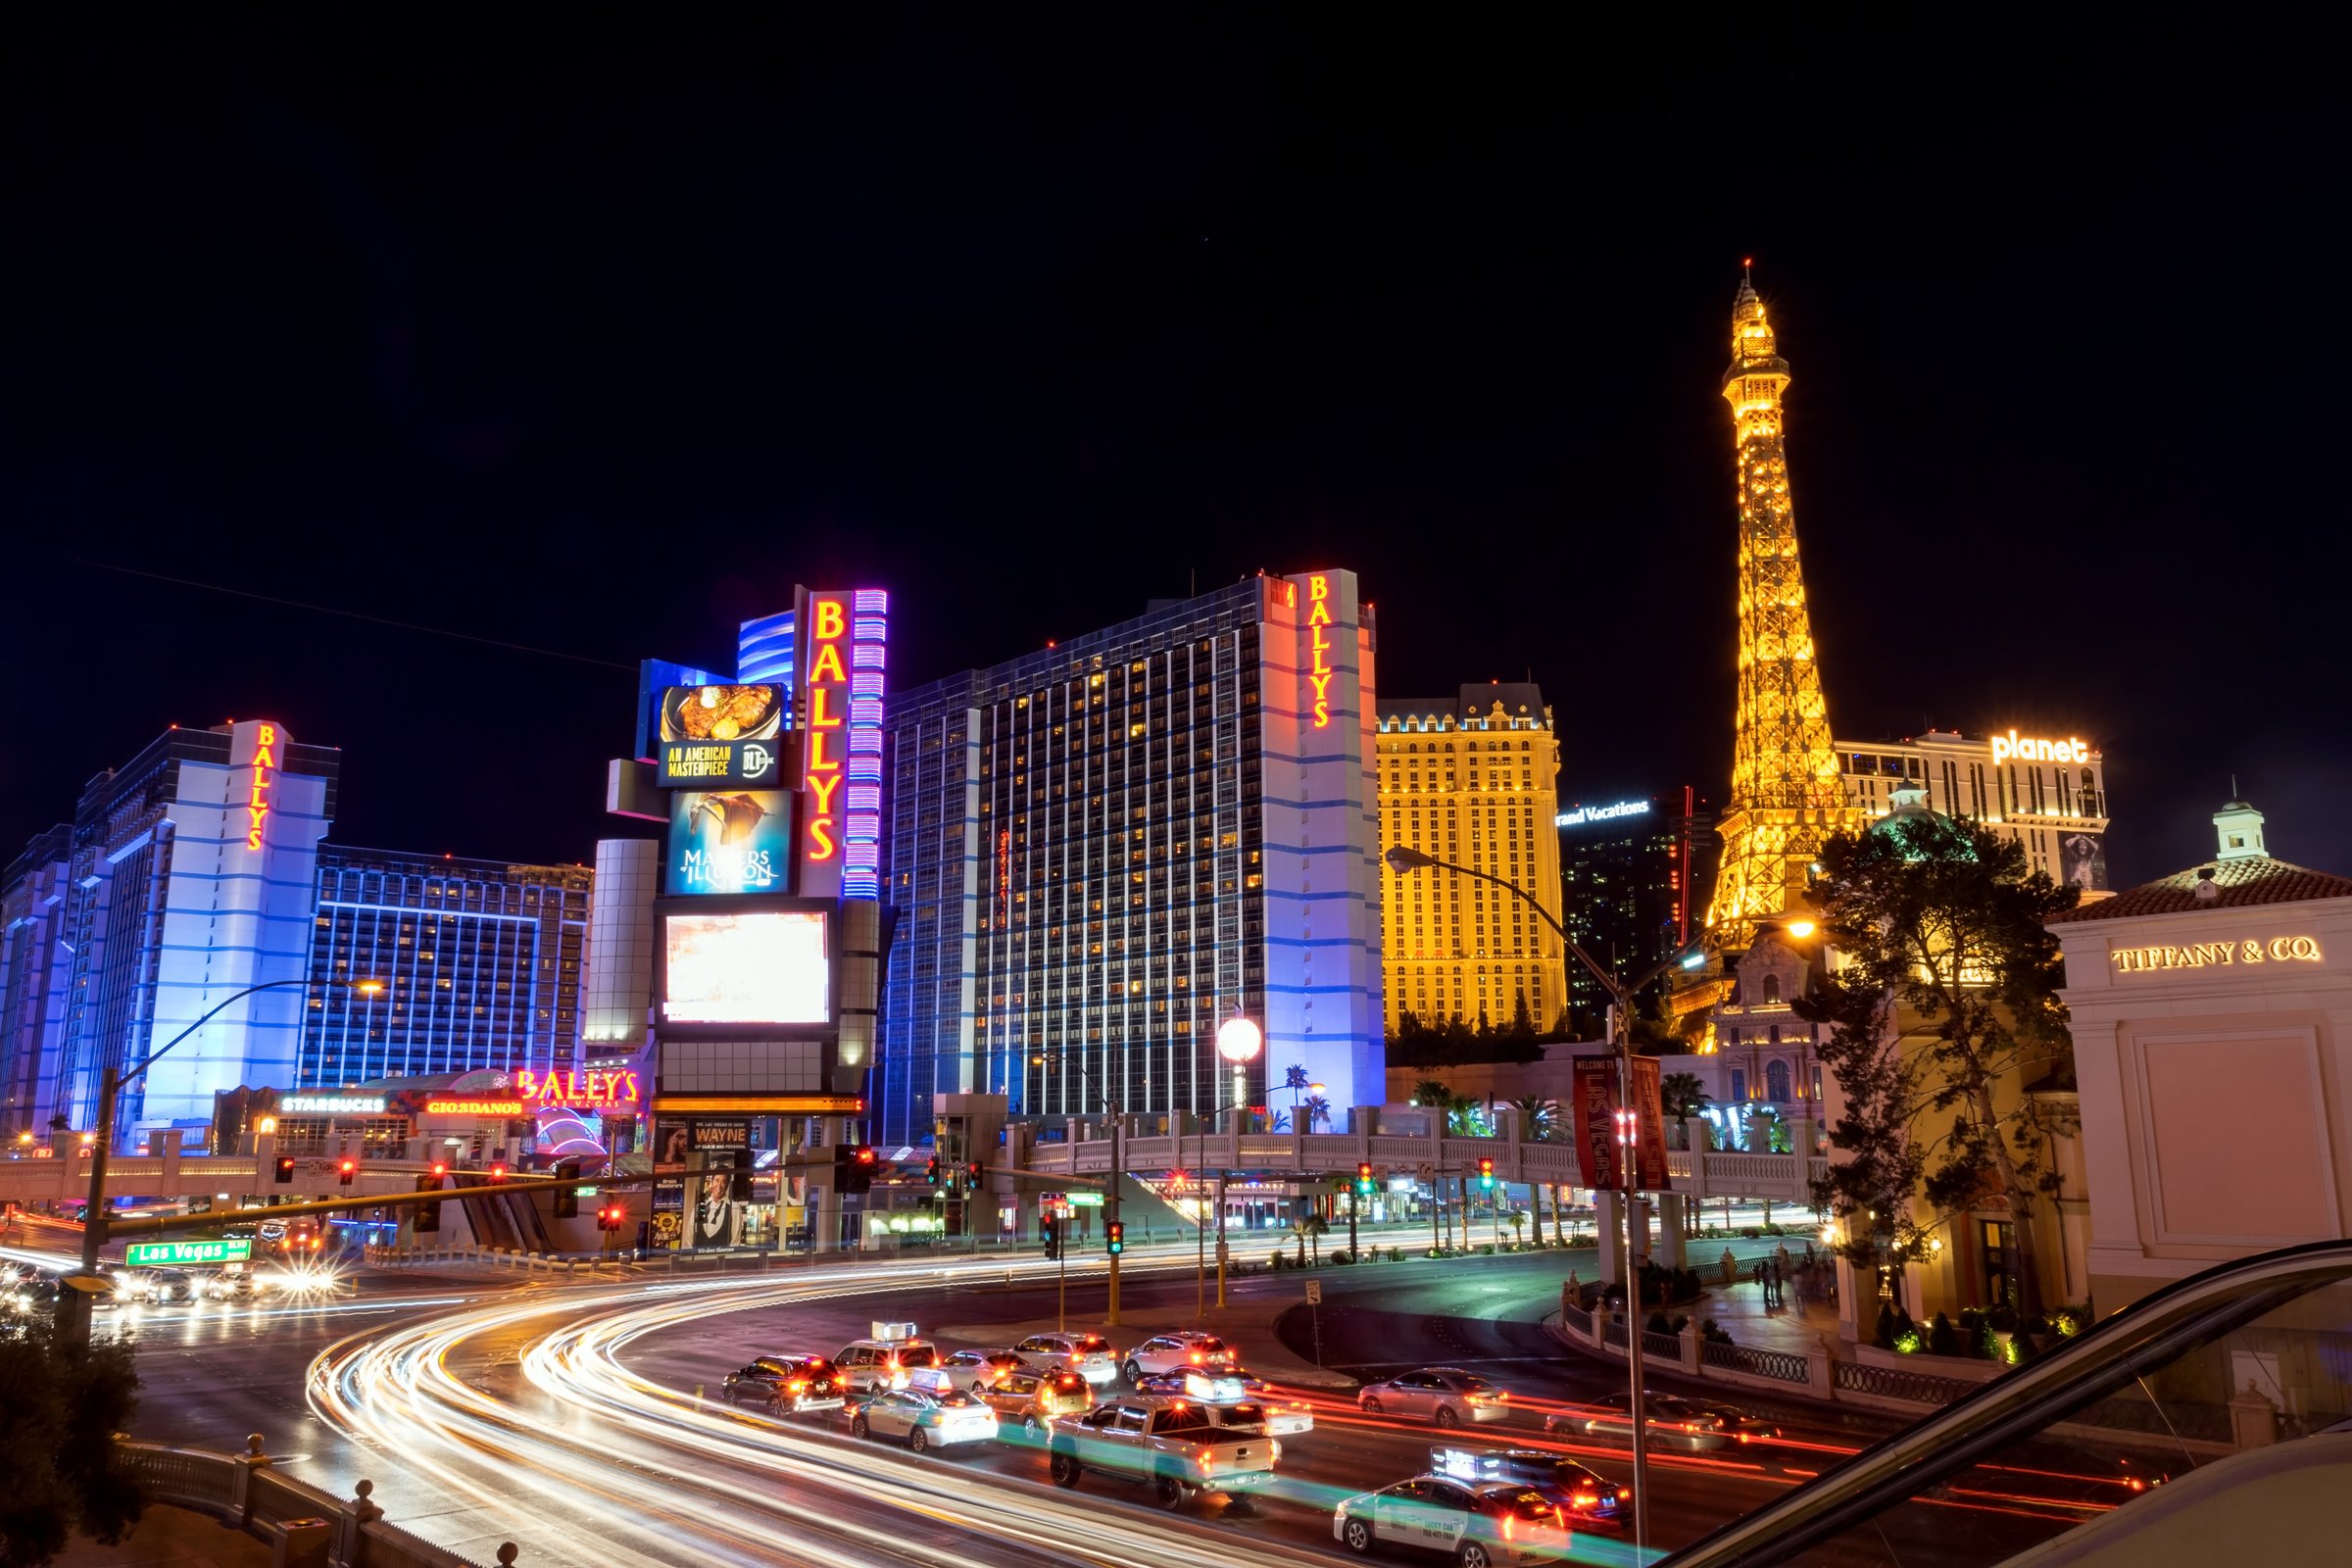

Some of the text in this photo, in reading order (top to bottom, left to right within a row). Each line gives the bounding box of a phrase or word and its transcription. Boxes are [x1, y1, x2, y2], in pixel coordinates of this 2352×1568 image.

[1308, 575, 1332, 728] BALLYS
[807, 601, 847, 860] BALLYS
[668, 746, 731, 762] AN AMERICAN
[1991, 729, 2088, 765] planet
[668, 760, 729, 777] MASTERPIECE
[743, 751, 762, 771] BLT
[247, 724, 274, 851] BALLYS
[1555, 801, 1650, 827] rand Vacations
[684, 849, 769, 866] MAERS
[2112, 942, 2235, 972] TIFFANY
[2241, 940, 2264, 963] &
[1576, 1059, 1615, 1070] WELCOME TO
[517, 1069, 639, 1102] BALLY'S
[281, 1098, 384, 1113] STARBUCKS
[427, 1102, 522, 1115] GIORDANO'S
[696, 1128, 746, 1143] WAYNE
[1586, 1074, 1612, 1185] LAS VEGAS
[139, 1246, 170, 1261] Las
[174, 1243, 222, 1262] Vegas
[1425, 1520, 1453, 1532] LUCKY CAB
